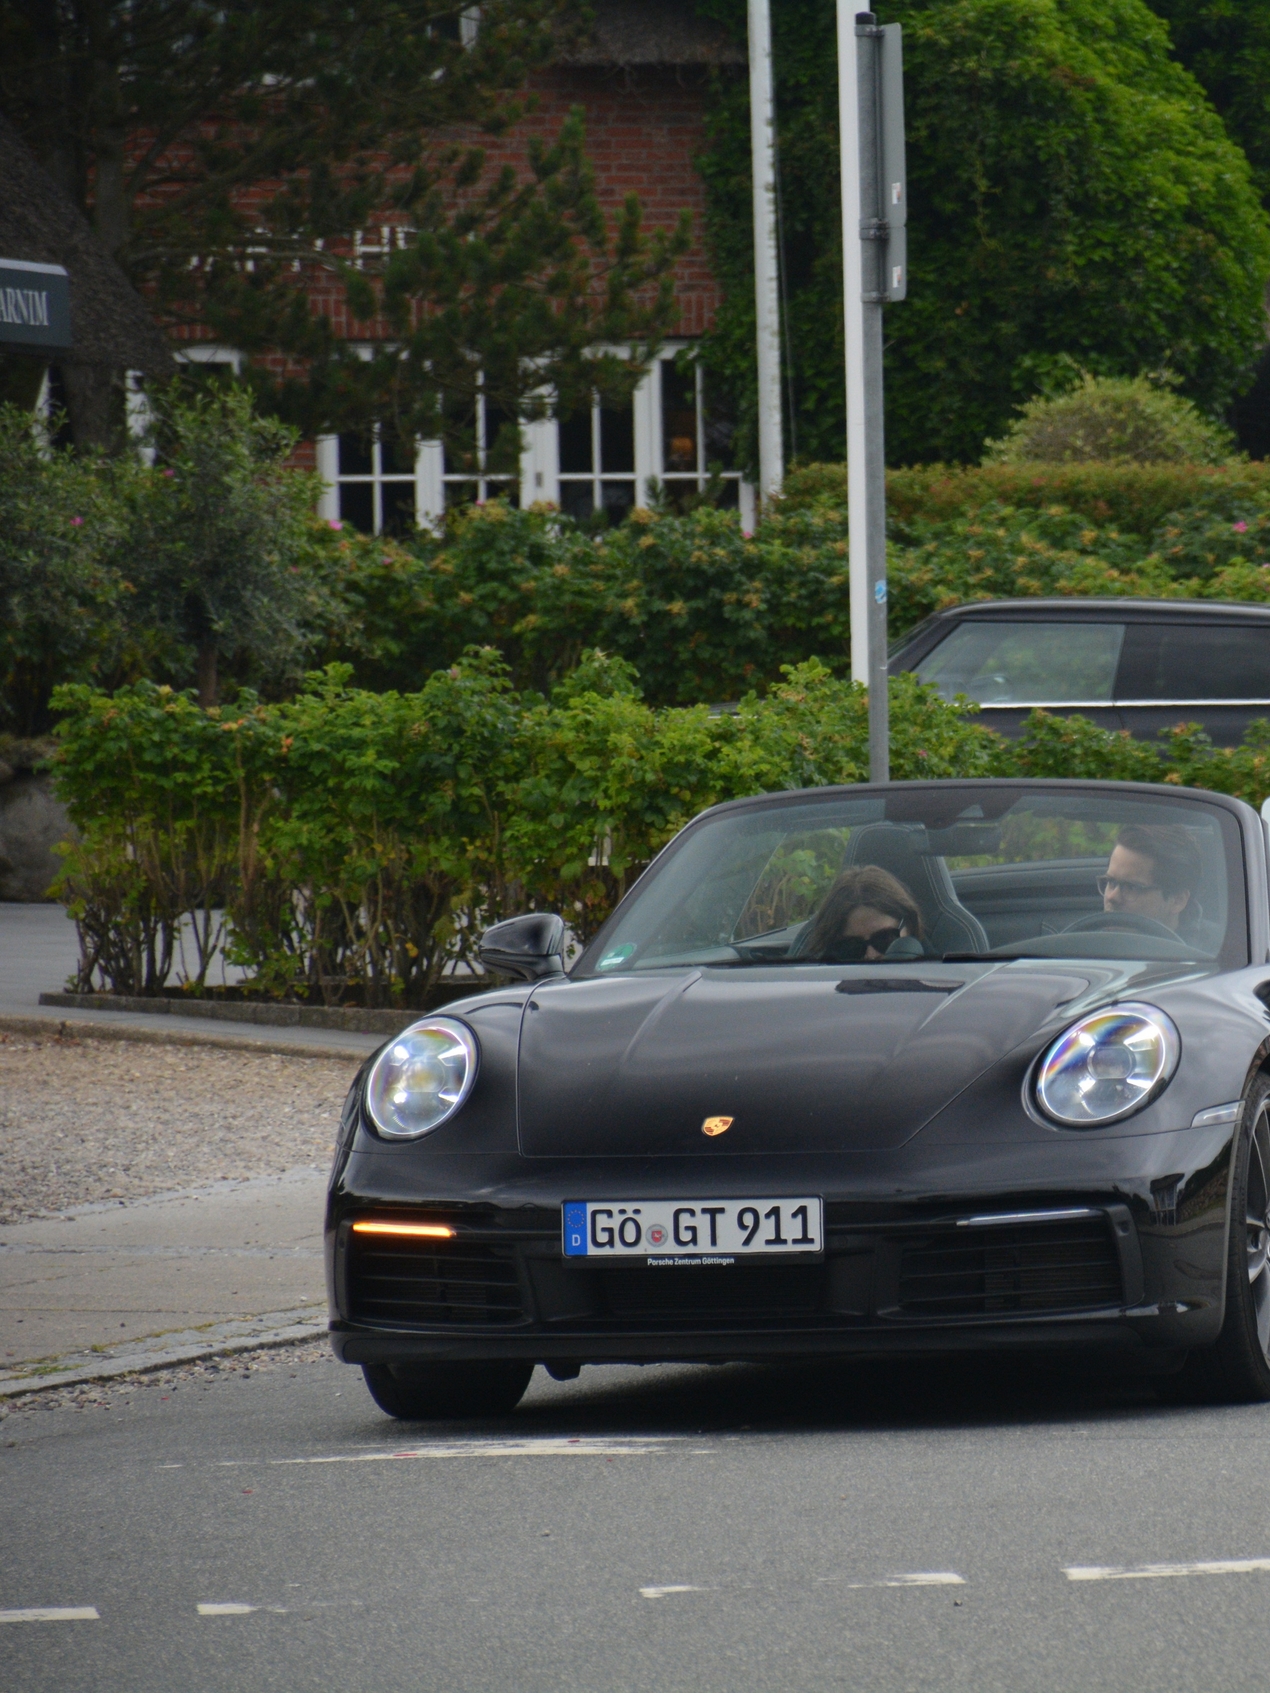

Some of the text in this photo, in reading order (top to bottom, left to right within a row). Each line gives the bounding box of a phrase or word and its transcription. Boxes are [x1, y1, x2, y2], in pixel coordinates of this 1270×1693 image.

[590, 1205, 815, 1249] GÖ GT 911
[571, 1234, 582, 1247] D
[647, 1256, 735, 1267] Porsche Zentrum Göttingen
